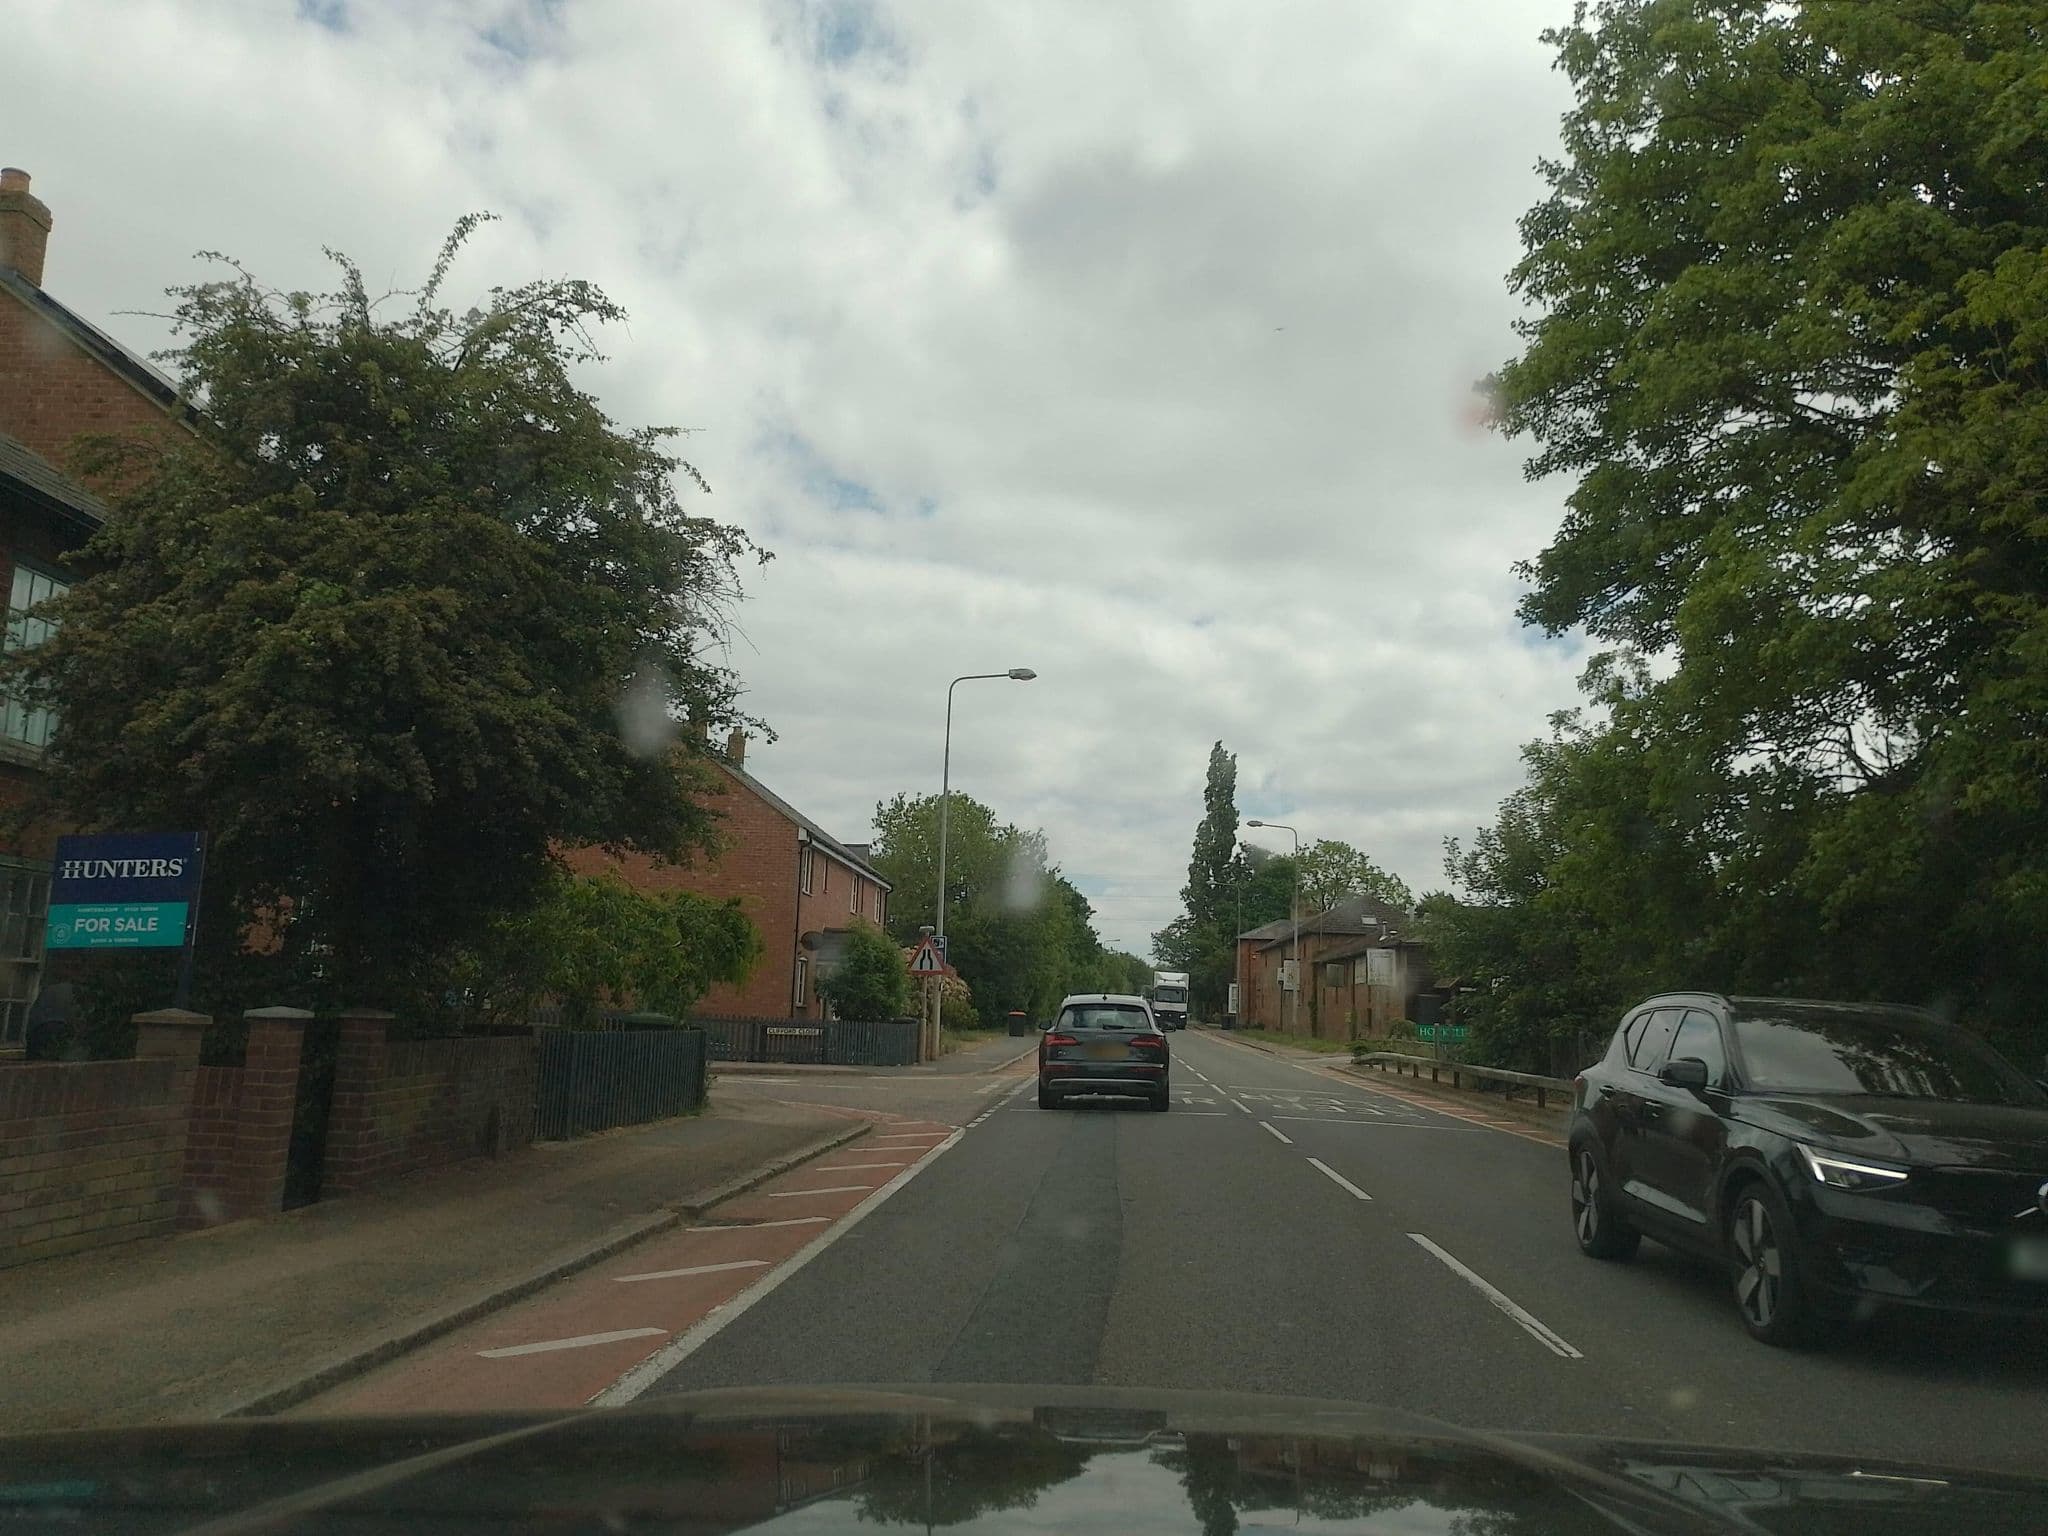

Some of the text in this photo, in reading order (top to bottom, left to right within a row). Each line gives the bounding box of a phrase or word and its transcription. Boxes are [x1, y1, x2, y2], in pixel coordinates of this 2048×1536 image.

[60, 858, 184, 879] HUNTERS
[75, 917, 159, 932] FOR SALE
